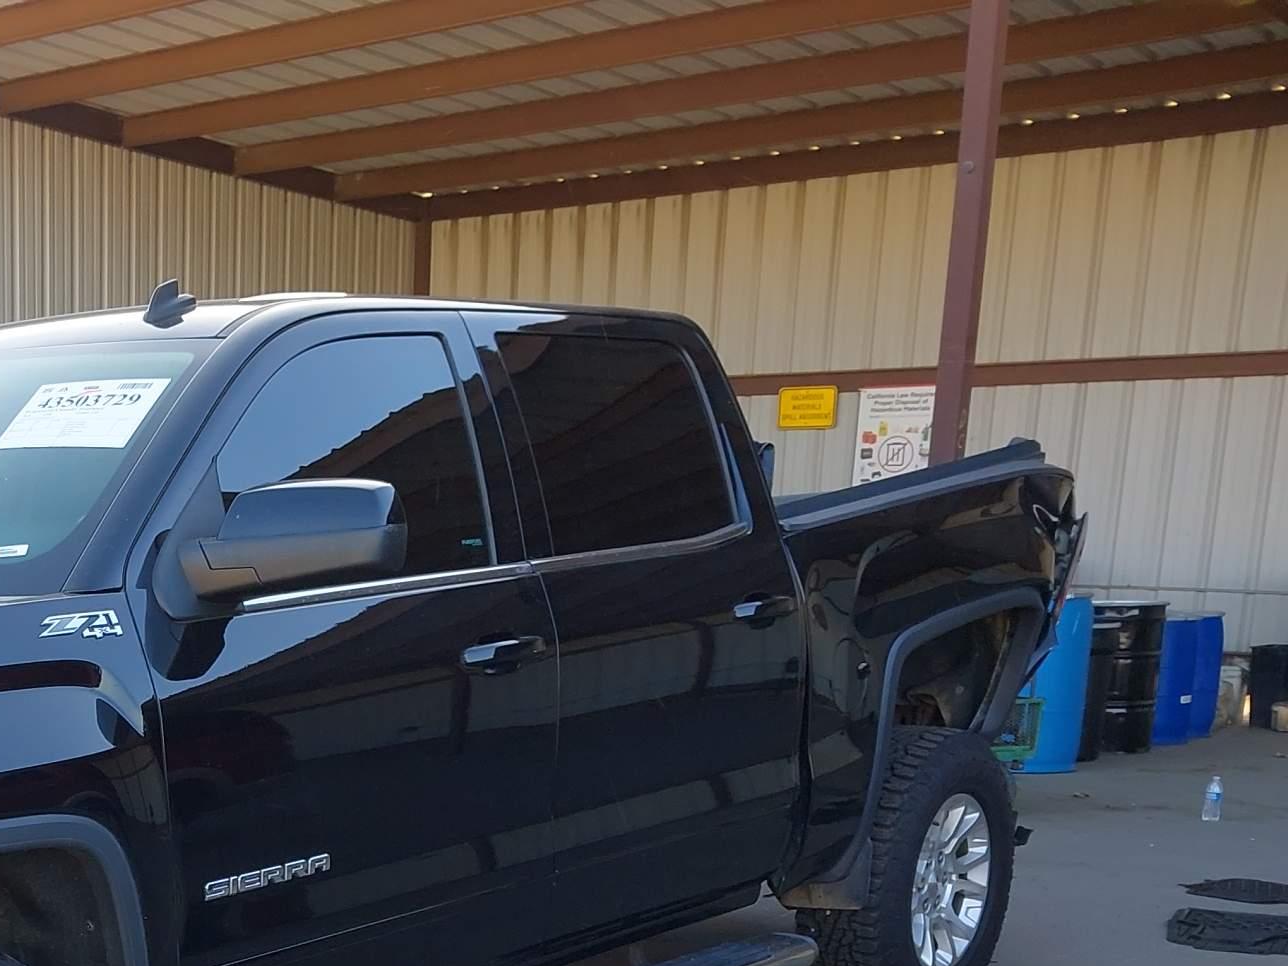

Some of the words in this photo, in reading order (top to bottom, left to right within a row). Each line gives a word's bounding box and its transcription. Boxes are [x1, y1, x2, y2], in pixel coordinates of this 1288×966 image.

[37, 393, 142, 409] 43503729
[38, 609, 119, 638] Z71
[204, 852, 331, 902] SIERRA
